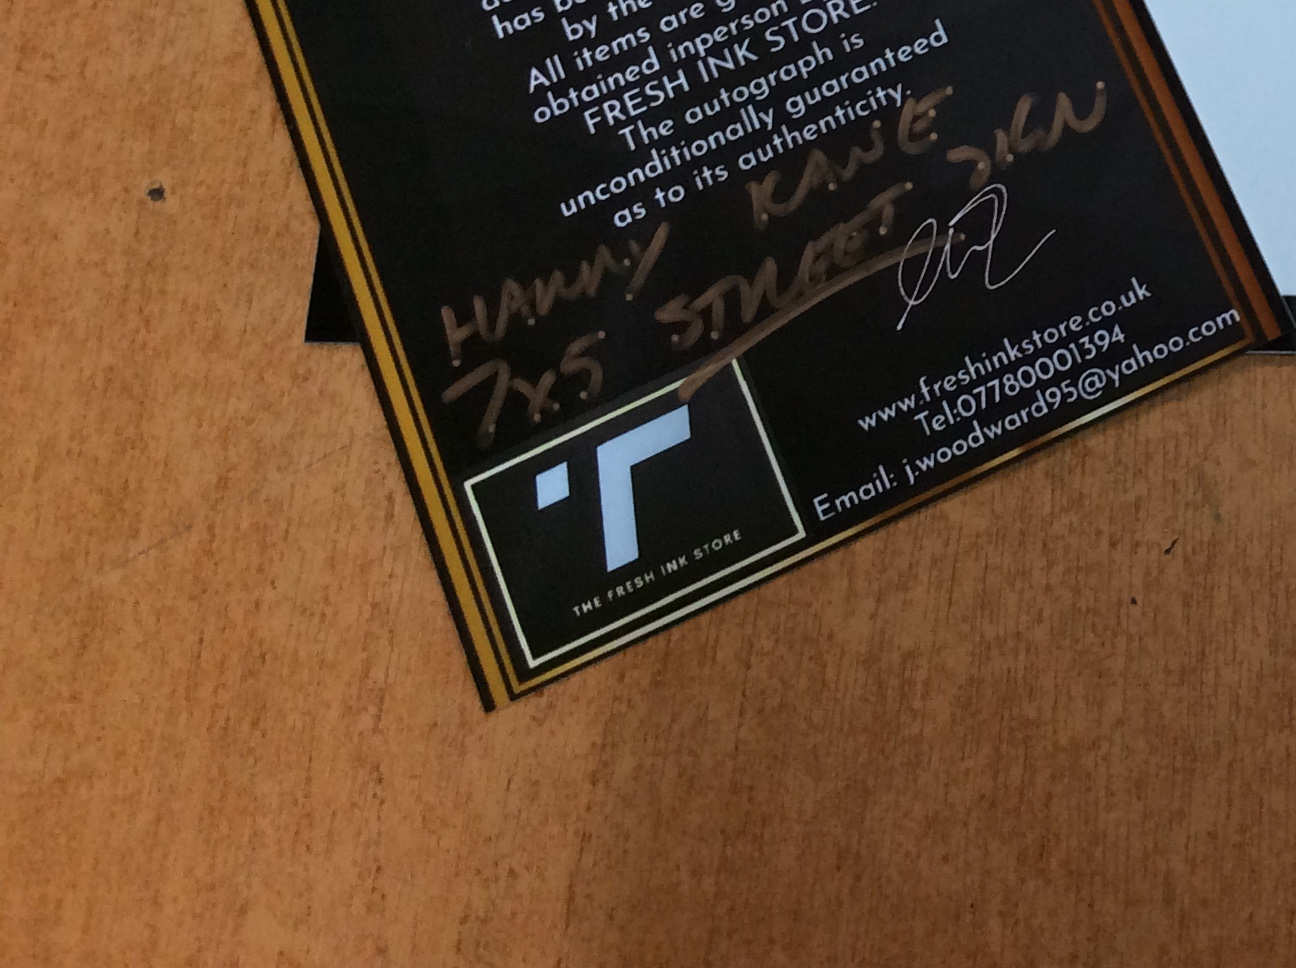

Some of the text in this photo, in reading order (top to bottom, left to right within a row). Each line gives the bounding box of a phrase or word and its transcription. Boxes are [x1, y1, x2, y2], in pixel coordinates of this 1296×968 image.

[490, 5, 546, 40] has
[528, 52, 567, 95] All
[572, 25, 652, 72] items
[658, 1, 706, 34] are
[559, 13, 598, 43] by
[532, 44, 662, 125] obtained
[559, 17, 950, 218] unconditionally guaranteed
[582, 67, 691, 136] FRESH
[696, 36, 760, 84] INK
[616, 32, 866, 152] The autograph is
[612, 82, 912, 229] as to its authenticity.
[856, 275, 1153, 432] www.freshinkstore.co.uk
[912, 322, 1126, 437] Tel:07780001394
[811, 307, 1242, 522] Email: j.woodward95@yahoo.com
[571, 528, 743, 618] THE FRESH INK STORE
